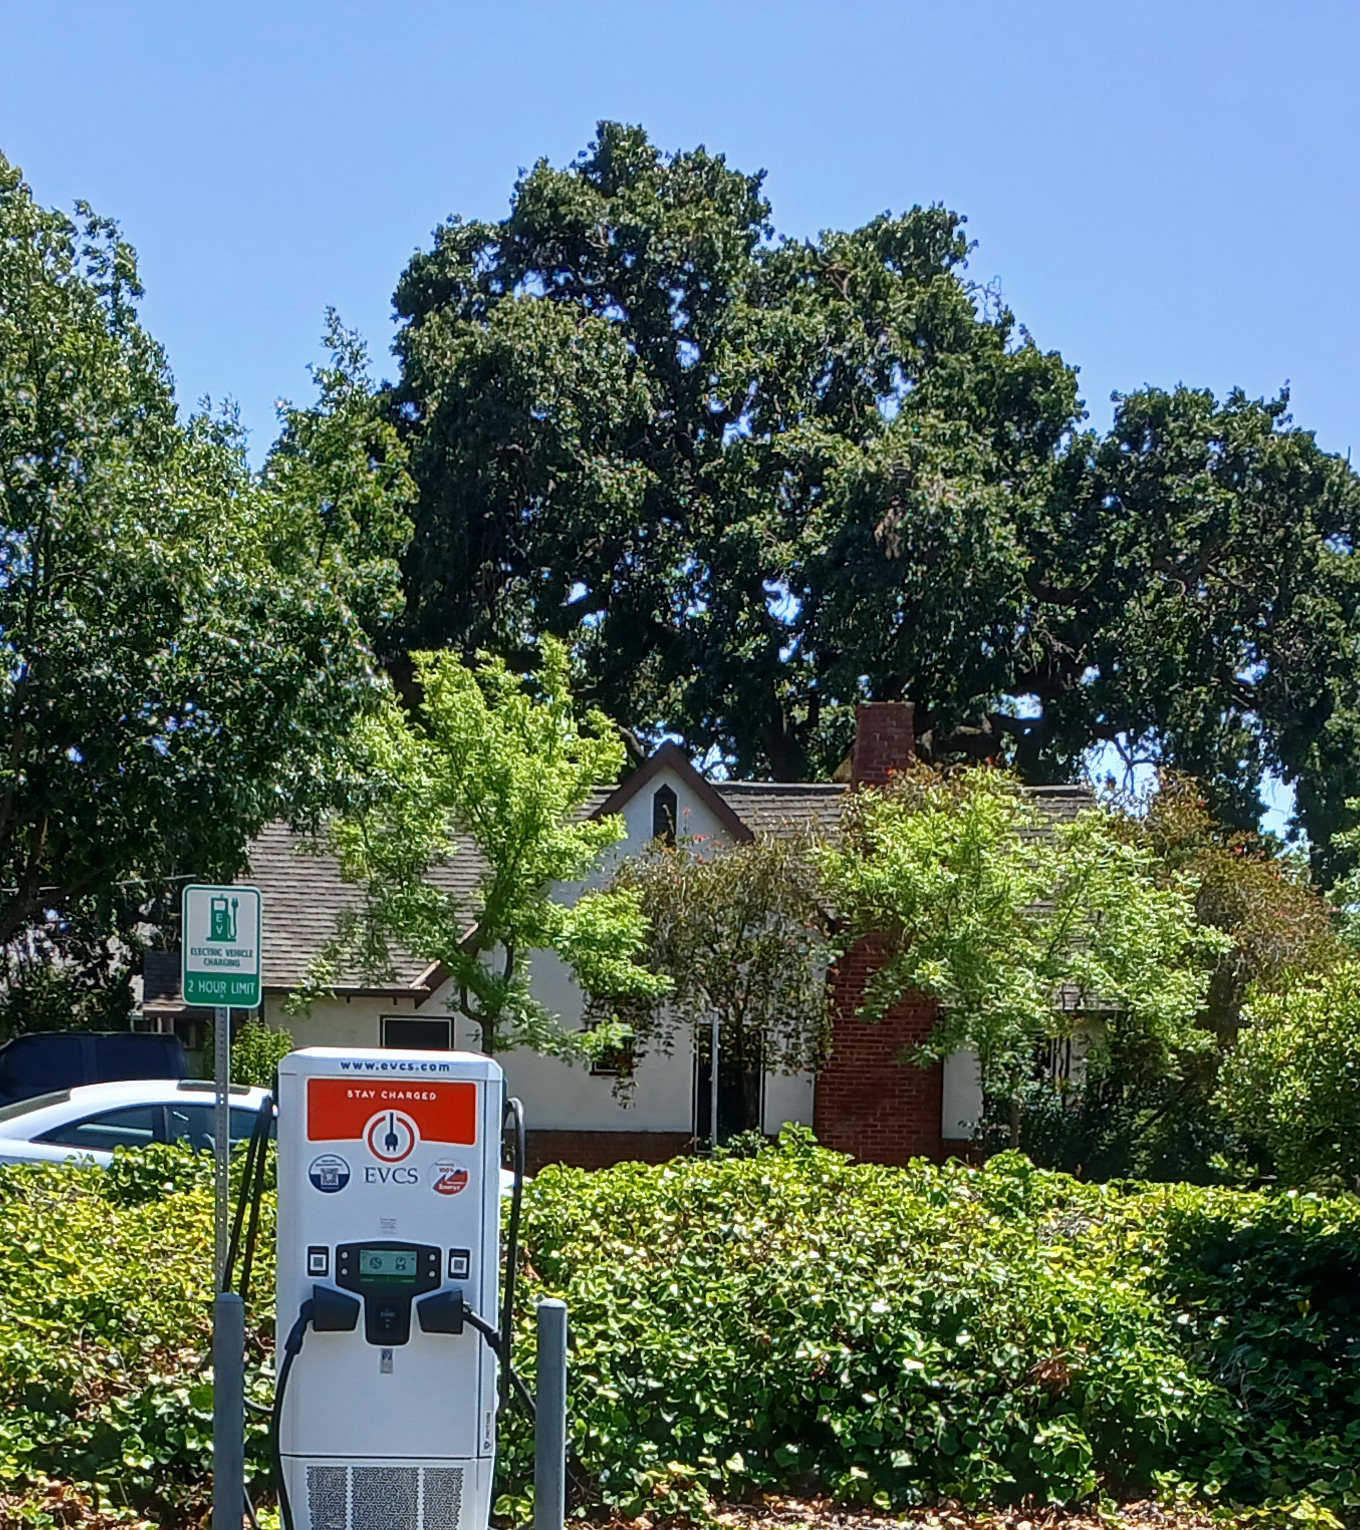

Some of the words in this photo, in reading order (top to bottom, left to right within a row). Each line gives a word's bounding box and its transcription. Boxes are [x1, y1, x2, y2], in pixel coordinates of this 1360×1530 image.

[215, 913, 224, 935] EV
[190, 947, 223, 957] ELECTRIC
[225, 948, 254, 958] VEHICLE
[203, 958, 241, 967] CHARGING
[187, 980, 194, 992] 2
[198, 980, 227, 994] HOUR
[231, 981, 256, 995] LIMIT
[340, 1061, 451, 1072] www.evcs.com
[347, 1090, 376, 1099] STAY
[381, 1090, 437, 1101] CHARGED
[364, 1166, 419, 1185] EVCS
